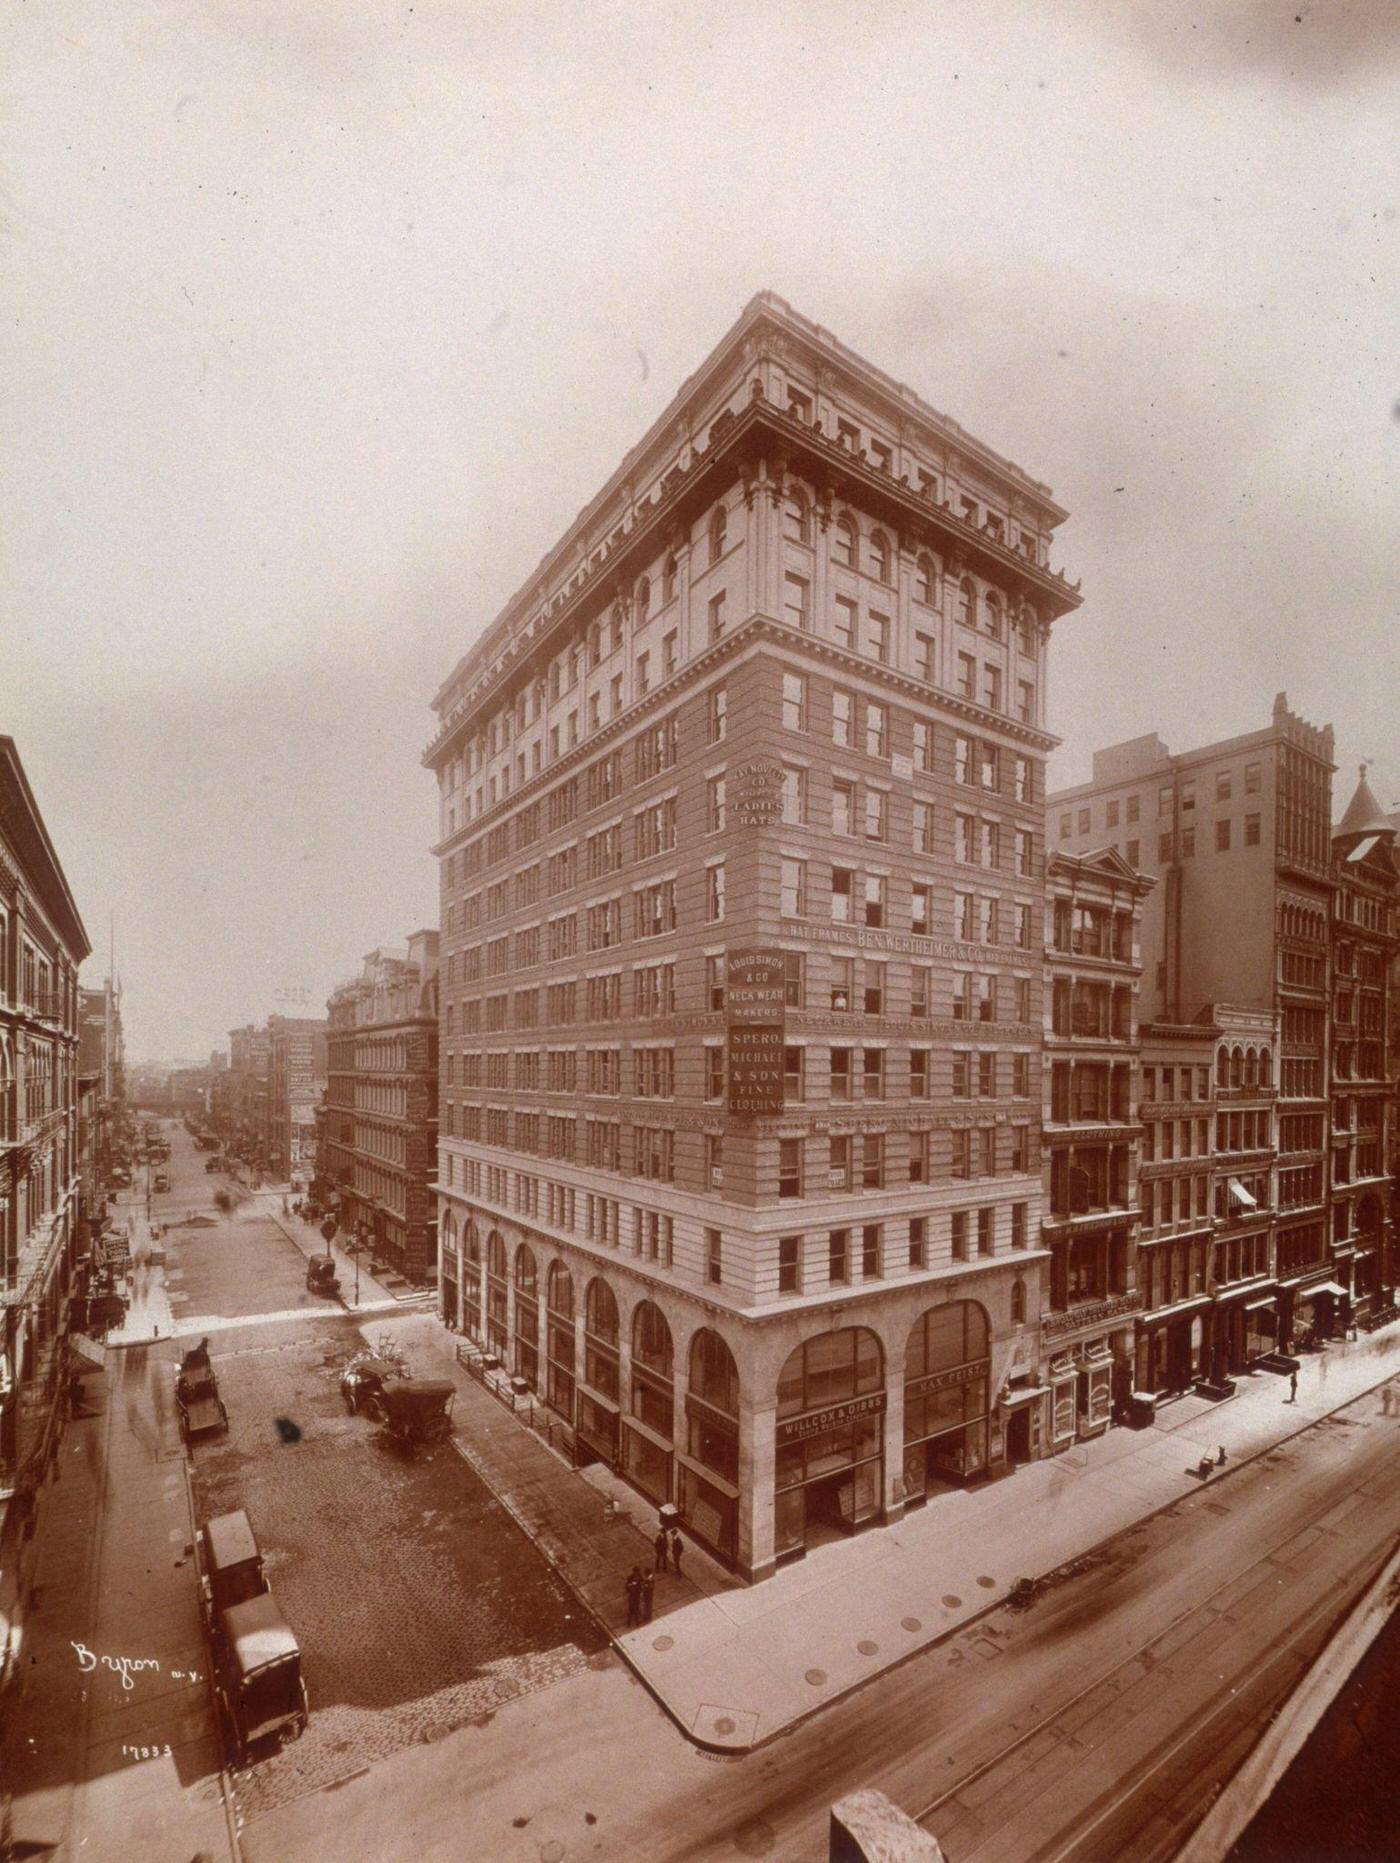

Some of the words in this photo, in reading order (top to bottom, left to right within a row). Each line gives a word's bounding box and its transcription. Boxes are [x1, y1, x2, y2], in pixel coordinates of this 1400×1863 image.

[734, 800, 785, 813] LADIES
[740, 814, 777, 826] HATS
[790, 925, 809, 938] HAT
[886, 934, 957, 961] WERTHEIMER
[958, 946, 967, 960] &
[729, 955, 755, 971] LOUIS
[756, 954, 784, 969] SIMON
[746, 973, 753, 983] &
[755, 972, 768, 983] CO
[730, 1052, 783, 1064] MICHAEL
[733, 1071, 742, 1081] &
[749, 1071, 780, 1082] SON
[740, 1086, 774, 1095] FINE
[730, 1099, 783, 1112] CLOTHING
[785, 1411, 836, 1434] WILLCOX
[837, 1408, 846, 1418] &
[848, 1397, 882, 1415] GIBBS
